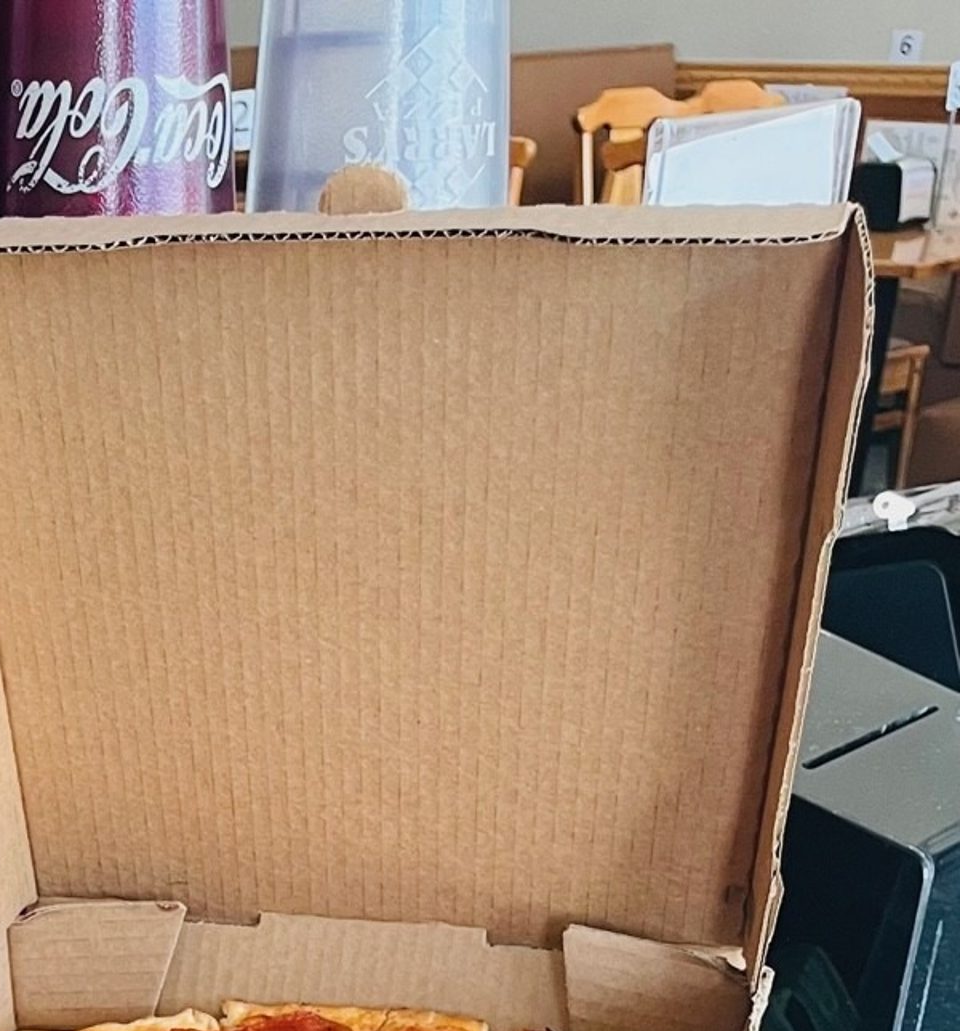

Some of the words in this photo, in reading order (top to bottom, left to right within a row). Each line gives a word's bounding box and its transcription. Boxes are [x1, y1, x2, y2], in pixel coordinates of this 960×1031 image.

[900, 34, 913, 55] 6
[233, 100, 249, 133] 2
[6, 72, 230, 195] Coca-Cola
